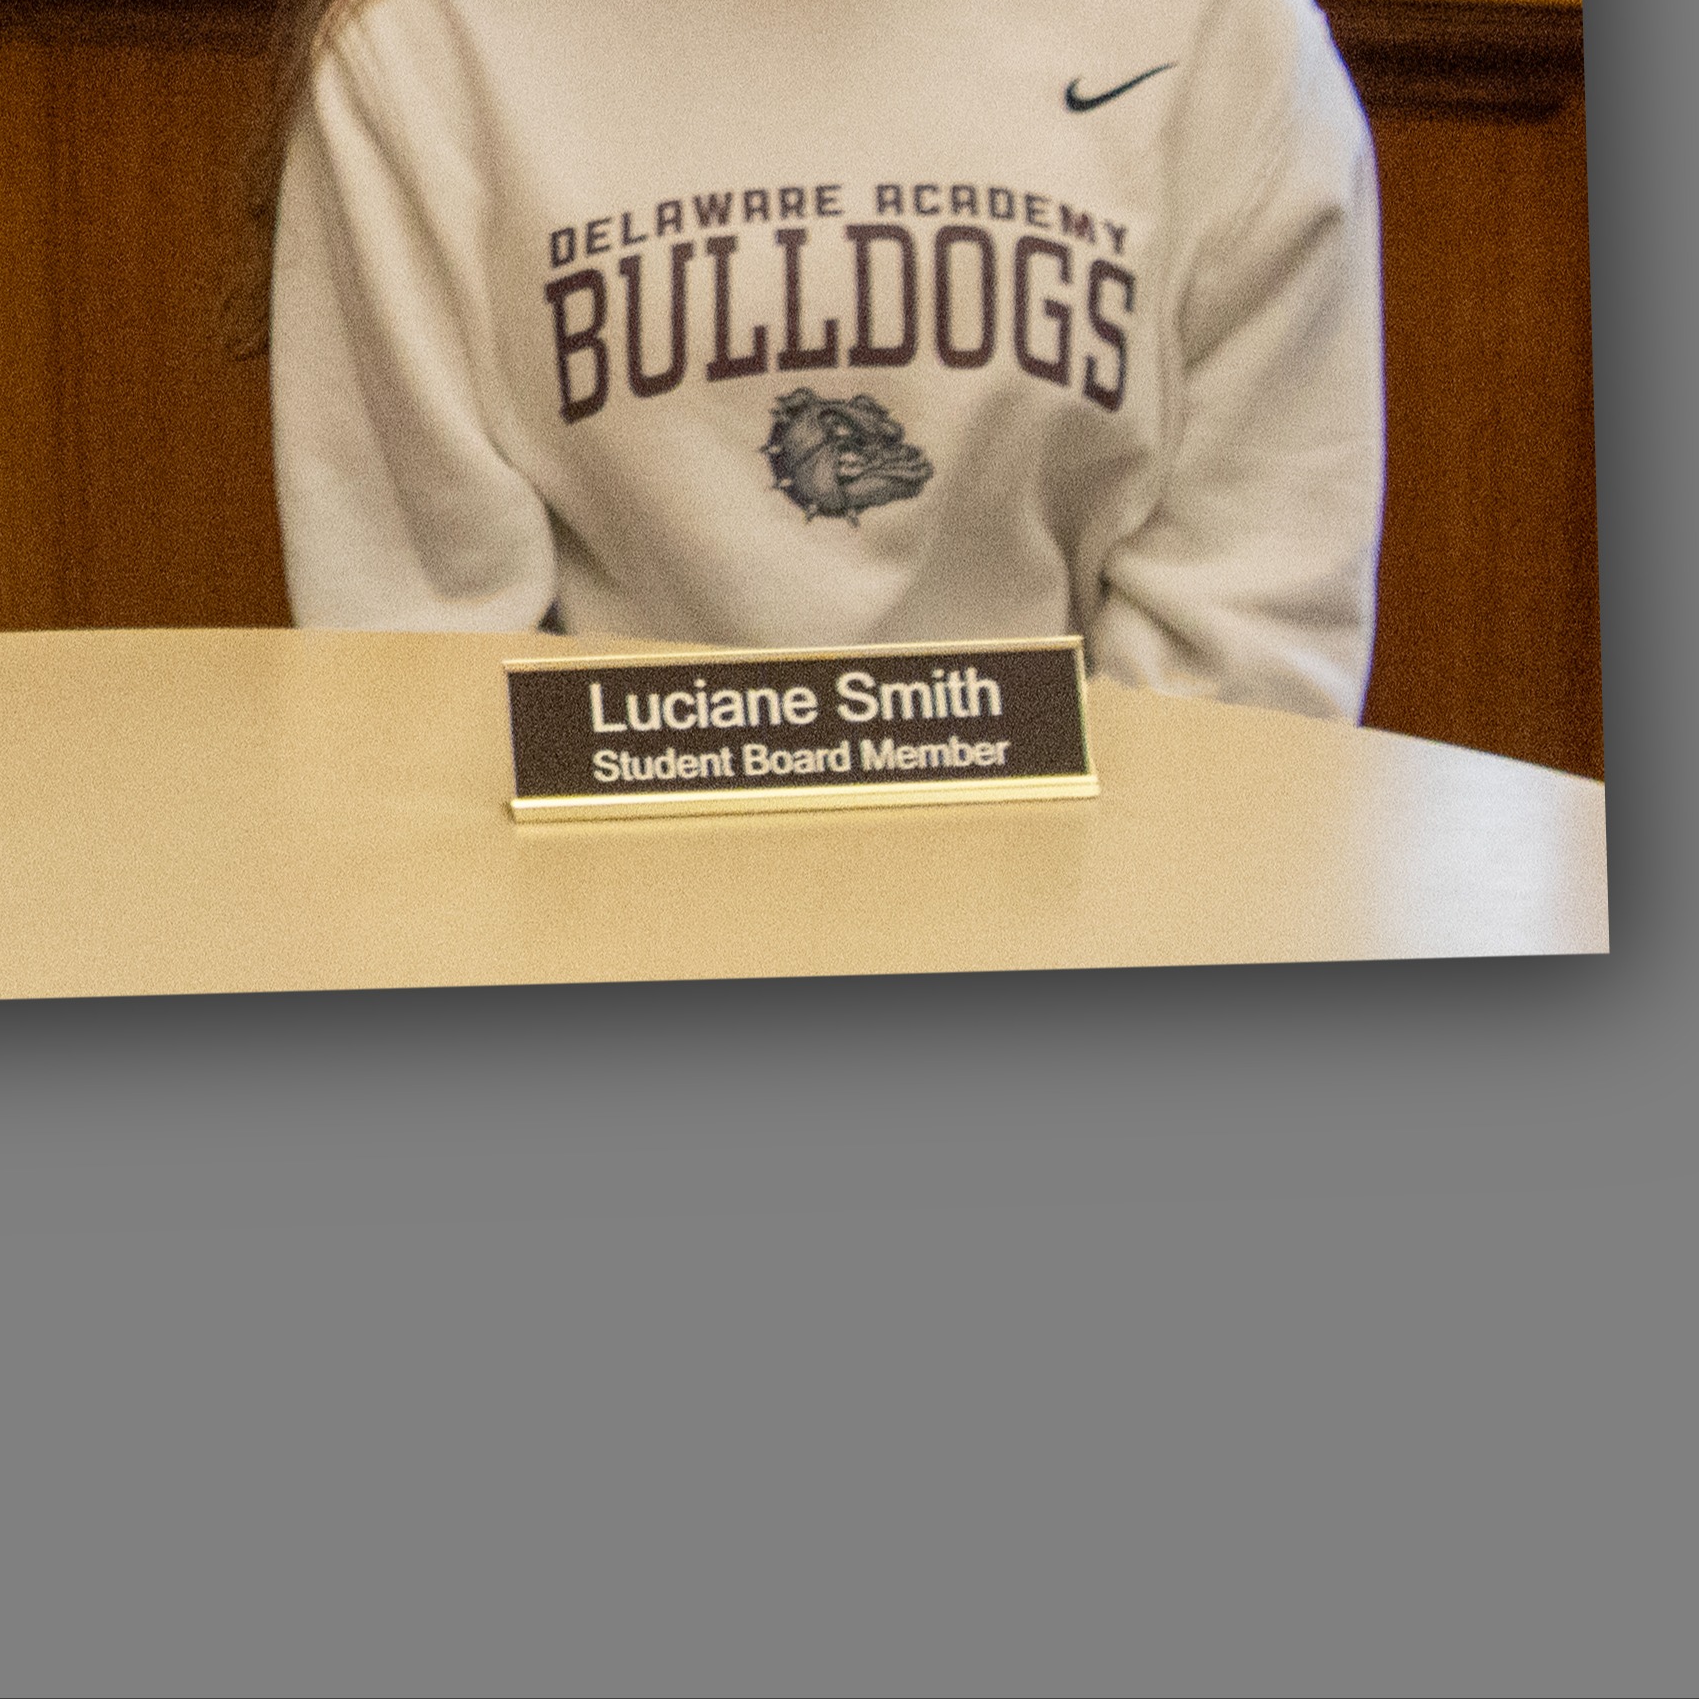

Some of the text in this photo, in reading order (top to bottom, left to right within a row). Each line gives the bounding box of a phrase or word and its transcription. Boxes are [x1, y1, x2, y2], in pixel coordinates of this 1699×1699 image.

[548, 183, 1130, 269] DELAWARE ACADEMY
[543, 222, 1137, 426] BULLDOGS
[589, 667, 1003, 734] Luciane Smith
[592, 735, 1011, 783] Student Board Member
